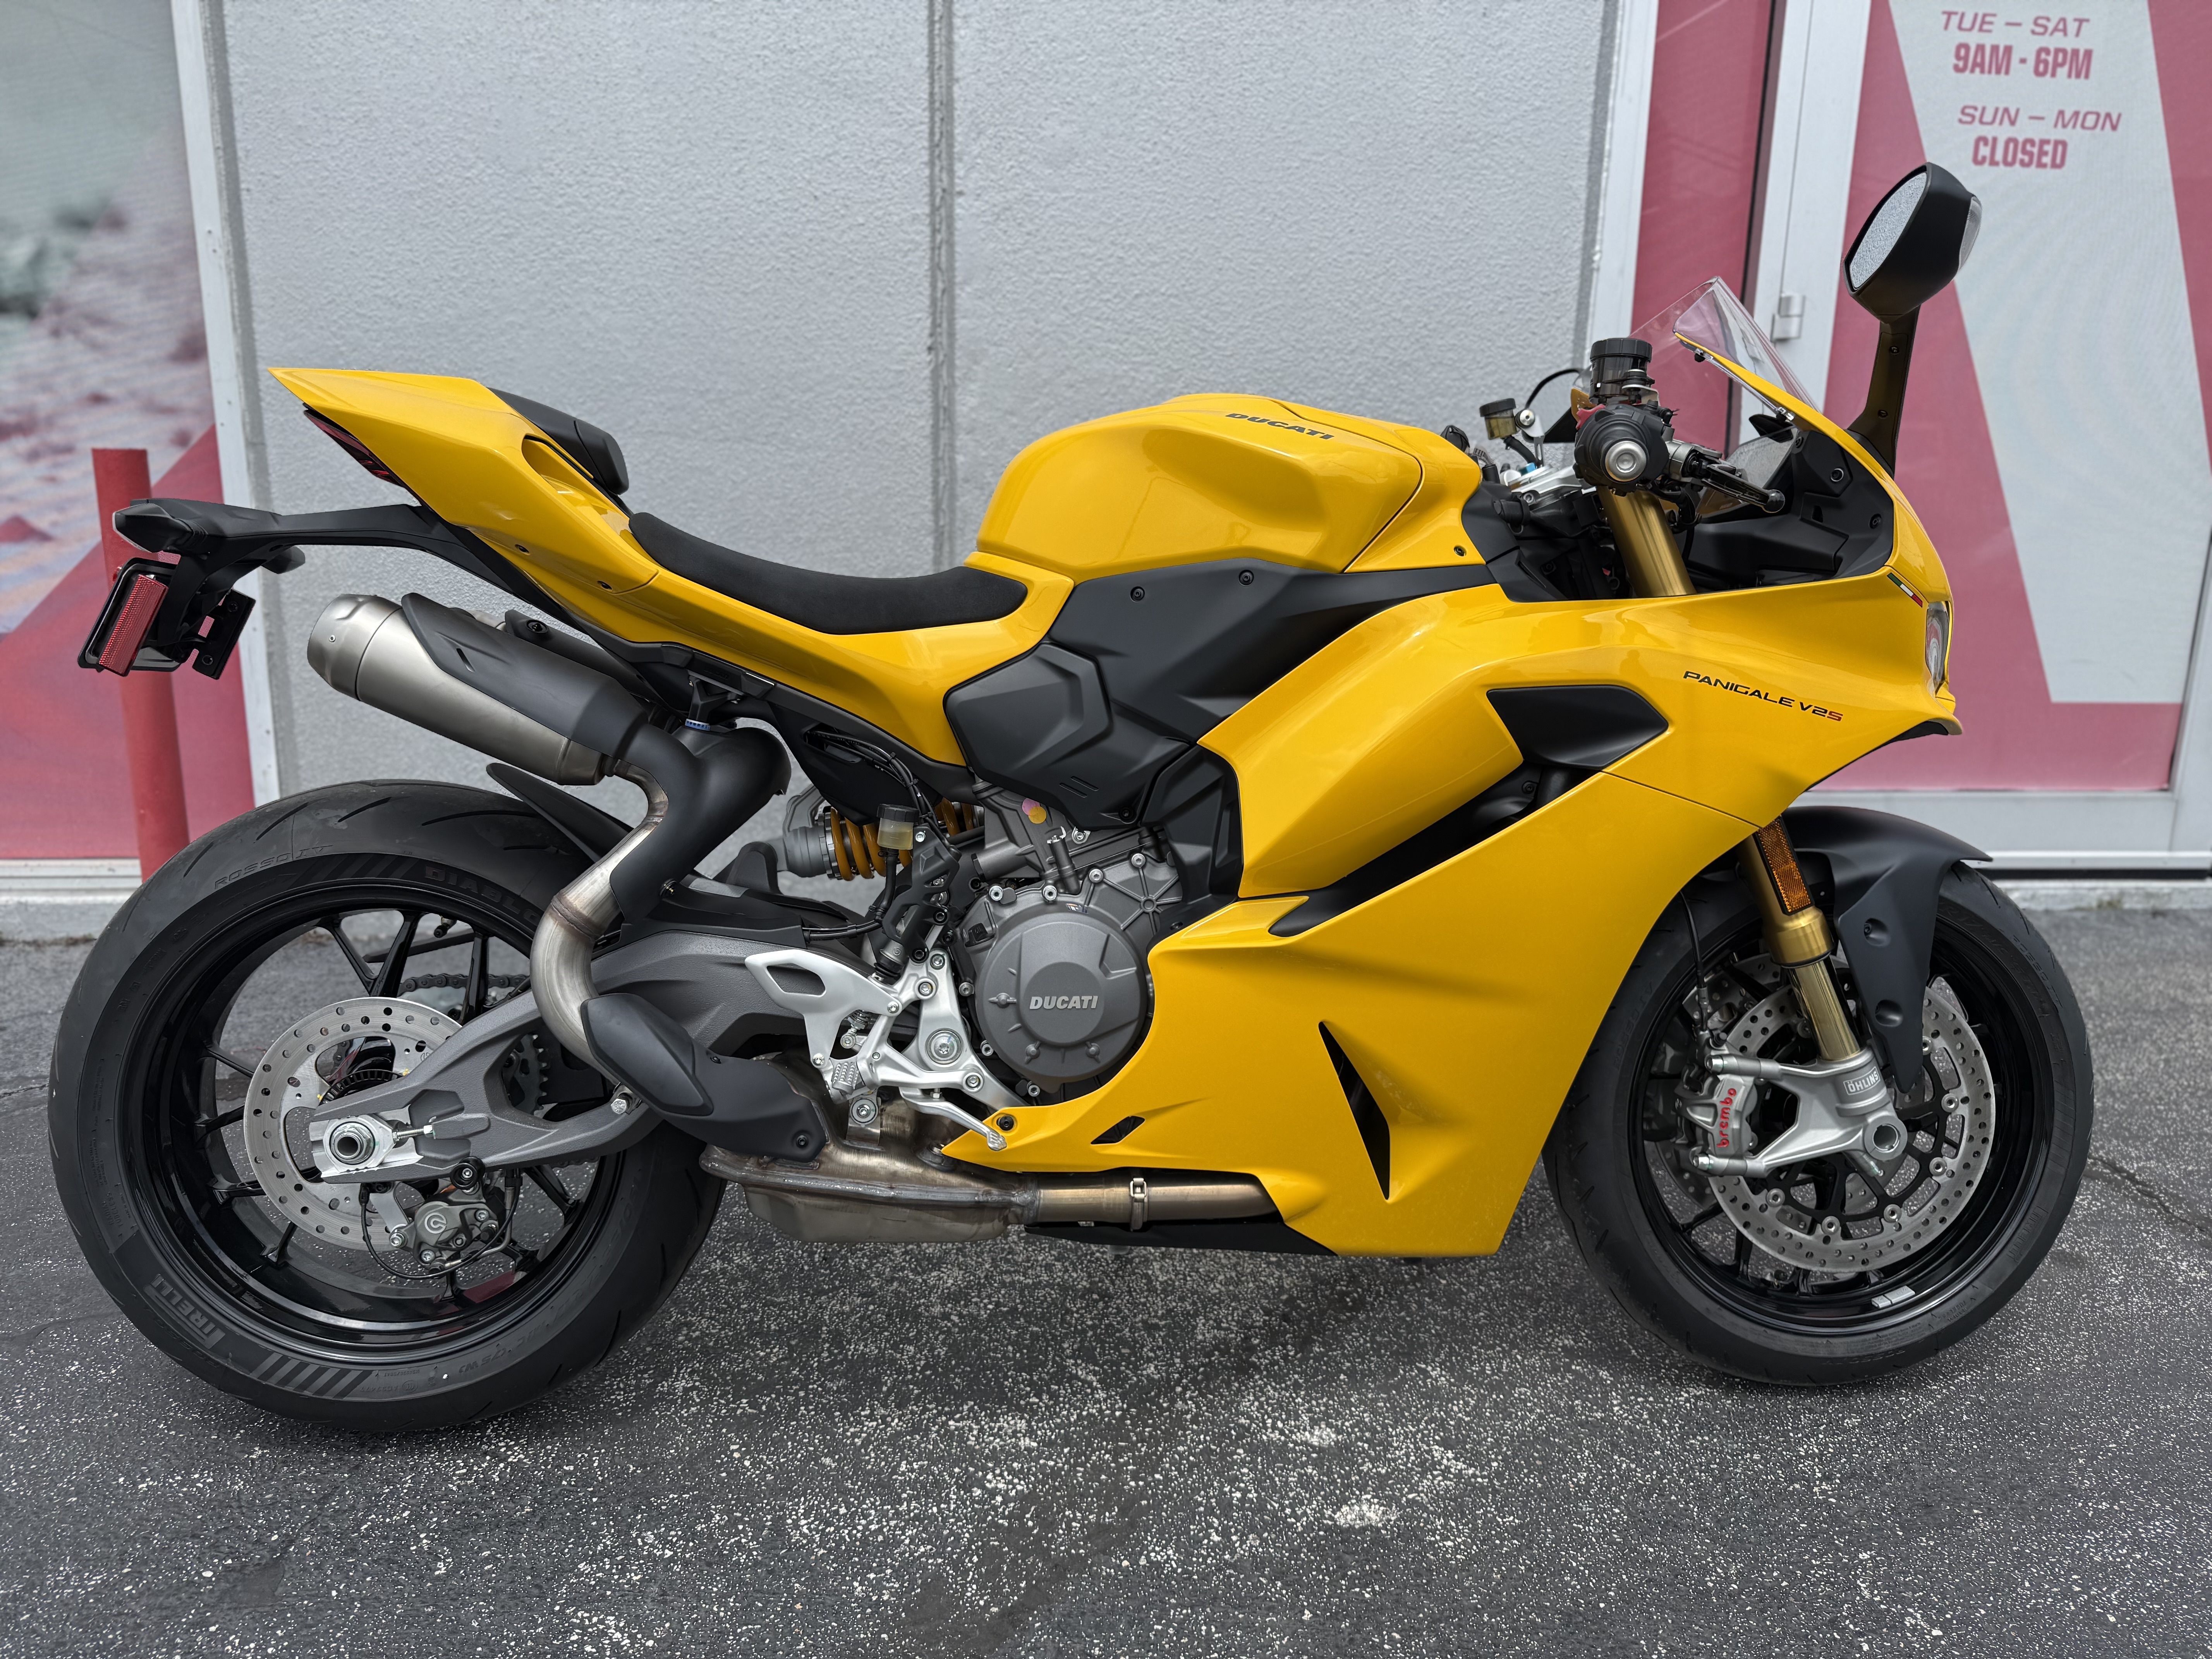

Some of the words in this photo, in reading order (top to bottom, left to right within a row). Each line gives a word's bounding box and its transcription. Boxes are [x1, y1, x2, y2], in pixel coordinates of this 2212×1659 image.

[1941, 11, 1997, 33] TUE
[2030, 16, 2090, 38] SAT
[1953, 43, 2013, 76] 9AM
[2033, 46, 2094, 79] 6PM
[1958, 105, 2020, 126] SUN
[2054, 110, 2122, 131] MON
[1972, 135, 2068, 169] CLOSED
[1225, 413, 1334, 440] DUCATI
[1683, 670, 1795, 708] PANIGALE
[1799, 701, 1843, 722] V2S
[214, 852, 292, 890] ROSSO
[1029, 996, 1098, 1009] DUCATI
[1847, 1070, 1879, 1092] ÖHLINS
[1716, 1088, 1736, 1148] brembo
[144, 1273, 225, 1349] PIRELLI
